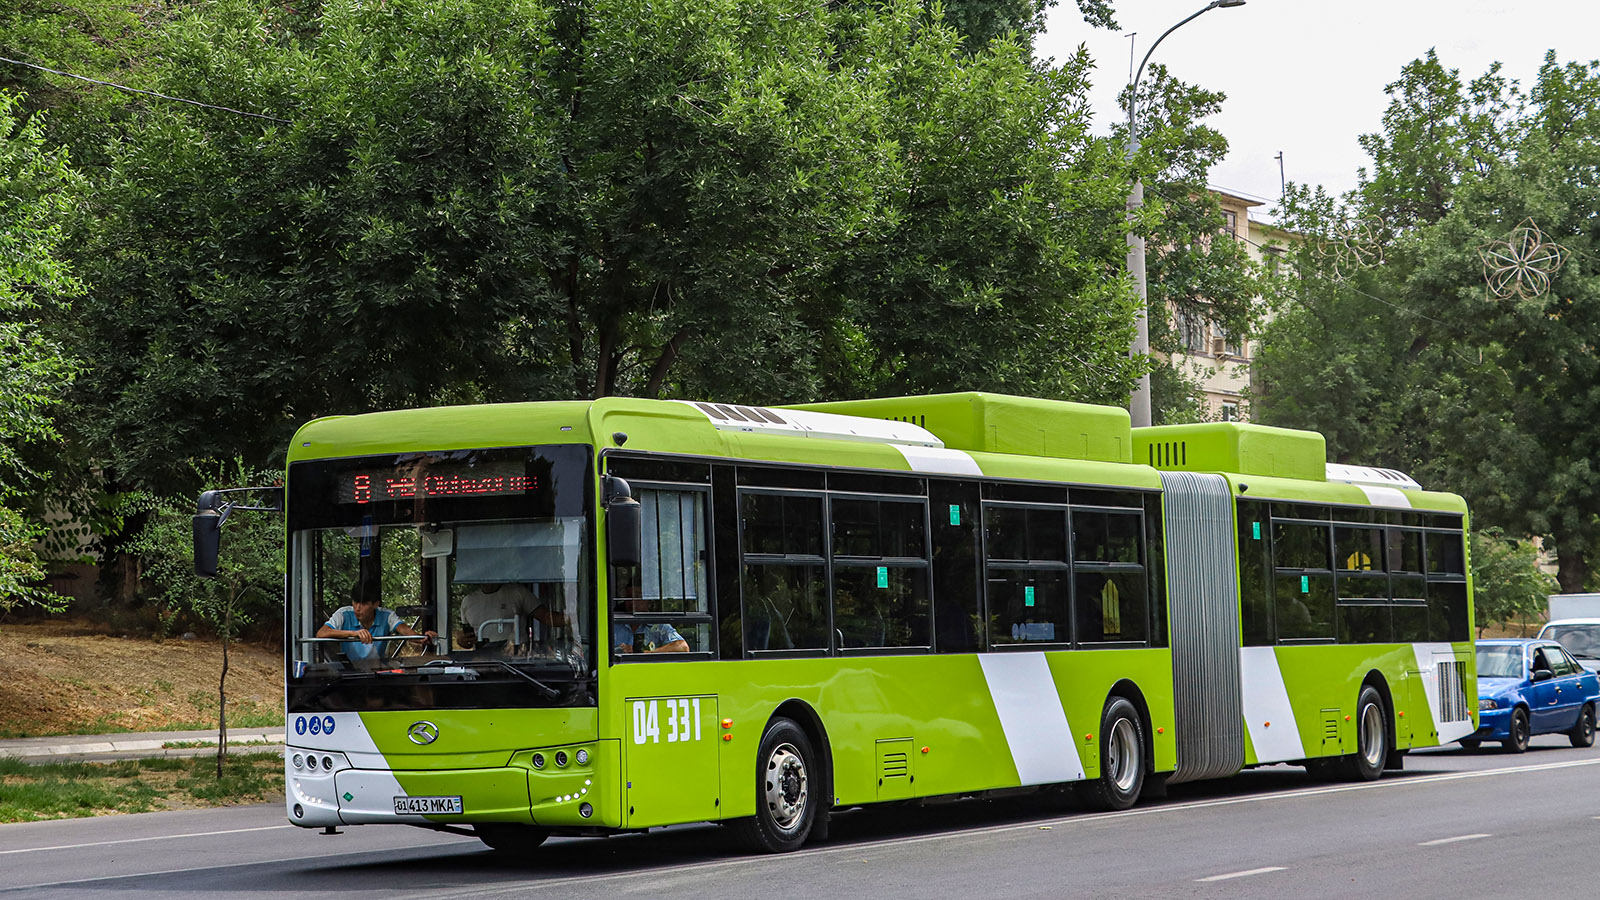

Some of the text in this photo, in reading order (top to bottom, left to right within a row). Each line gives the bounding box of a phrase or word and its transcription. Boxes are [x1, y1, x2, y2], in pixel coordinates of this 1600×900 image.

[633, 698, 701, 745] 04 331
[396, 799, 455, 812] 01 413 MKA
